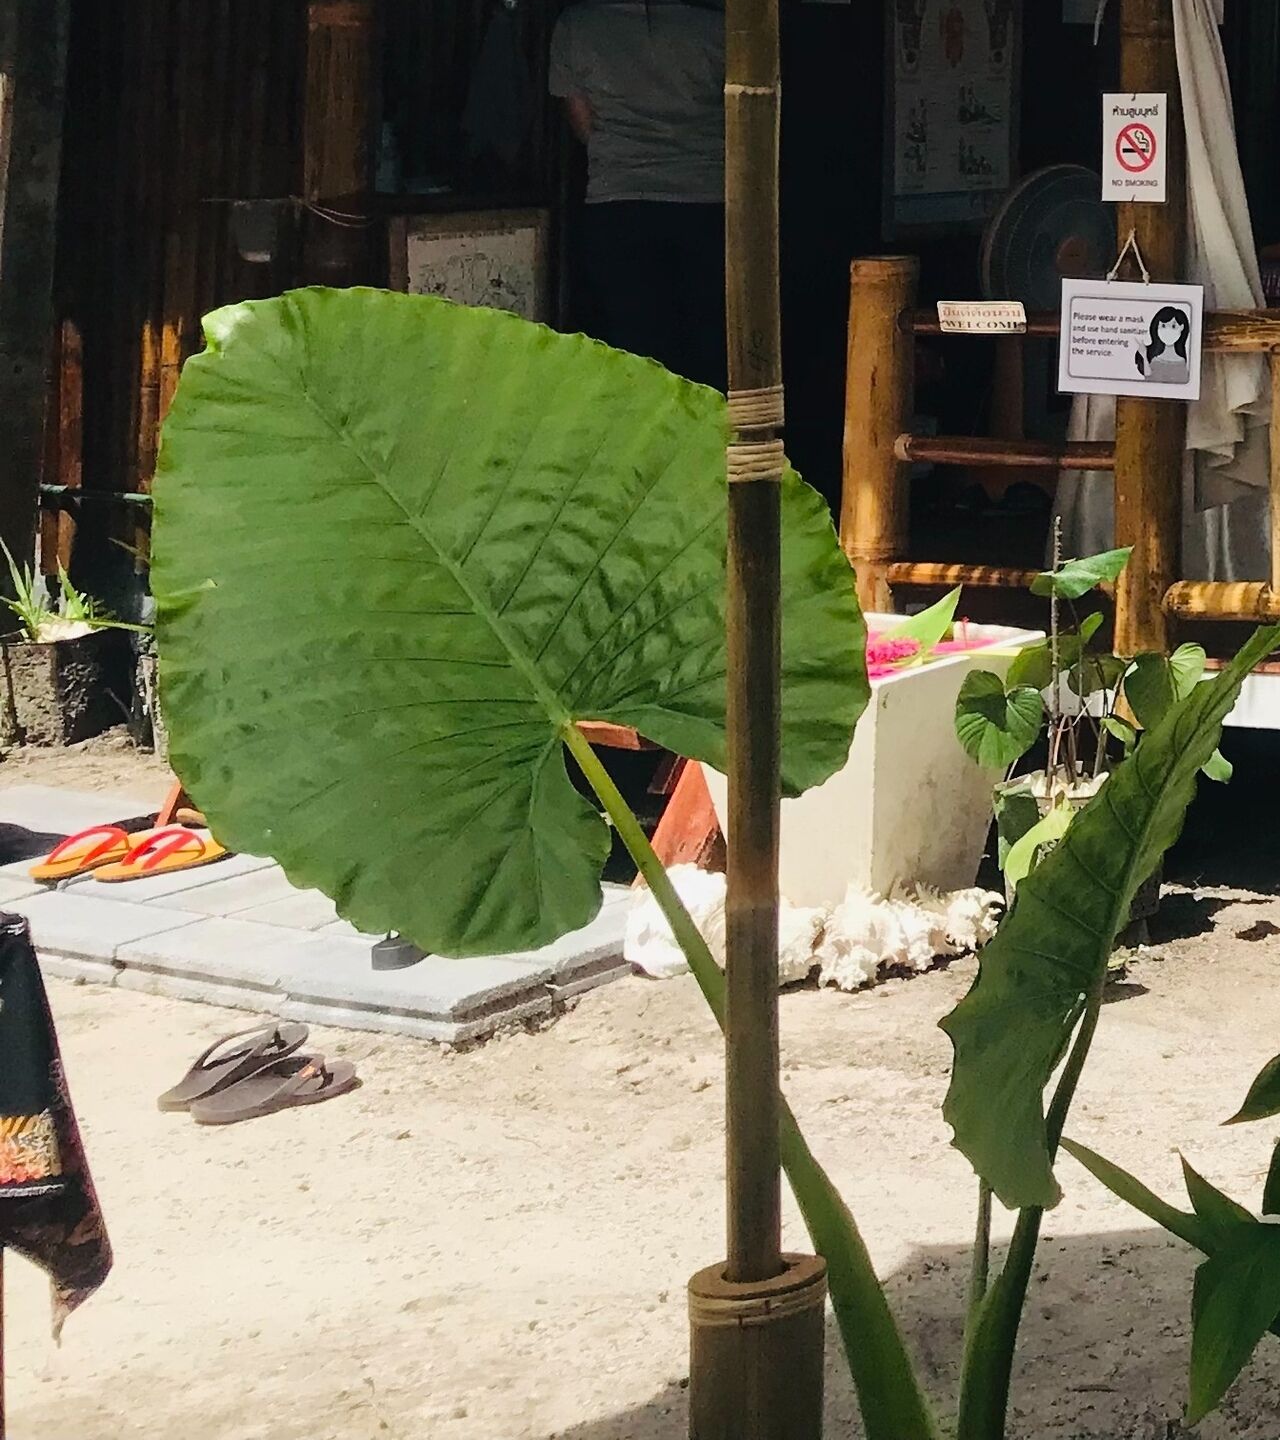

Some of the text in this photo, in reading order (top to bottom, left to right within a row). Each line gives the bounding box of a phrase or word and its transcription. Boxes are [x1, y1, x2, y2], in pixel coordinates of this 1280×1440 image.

[1112, 103, 1159, 118] ห้ามสูบบุหรี่
[1111, 179, 1158, 187] NO SMOKING
[1073, 312, 1097, 321] Please
[1125, 315, 1145, 323] mask
[1100, 325, 1119, 334] hand
[1072, 336, 1129, 348] before entering
[1071, 347, 1084, 355] the
